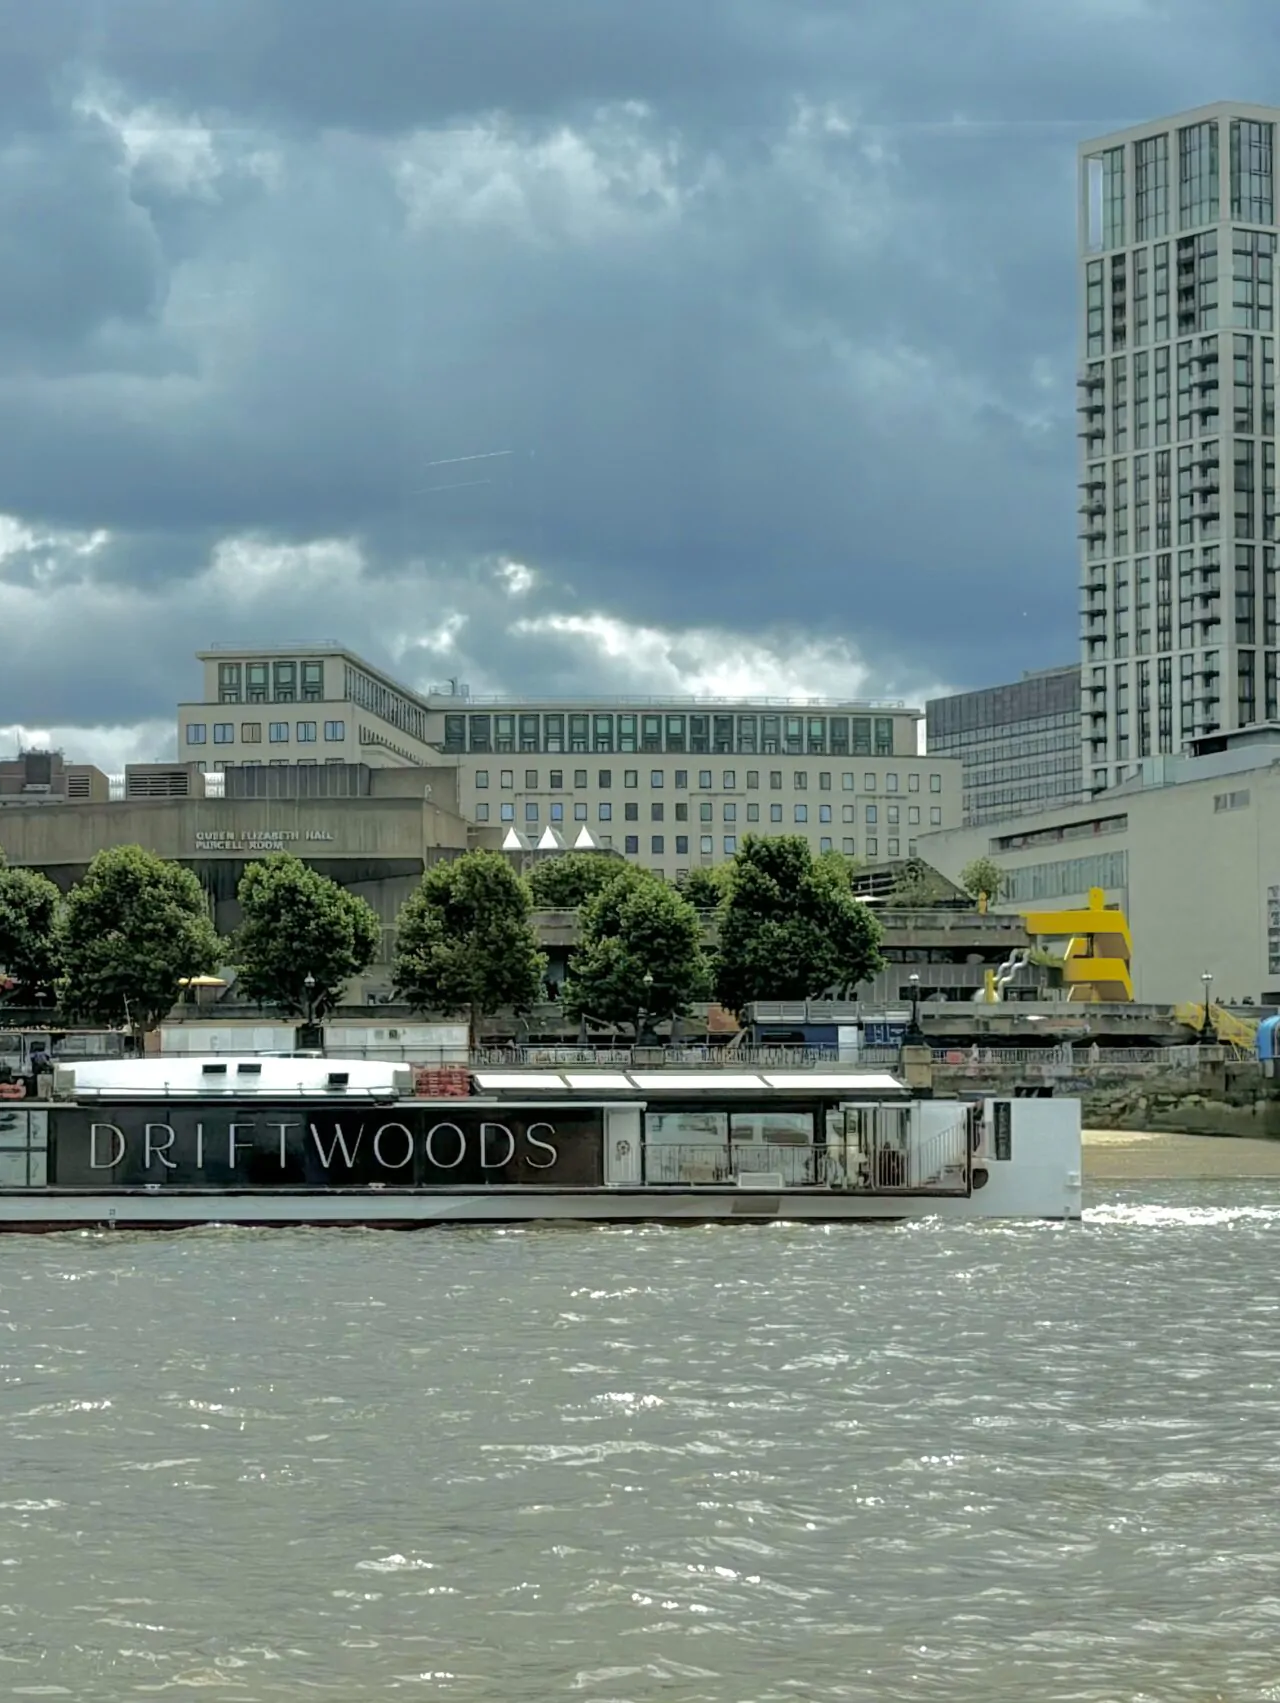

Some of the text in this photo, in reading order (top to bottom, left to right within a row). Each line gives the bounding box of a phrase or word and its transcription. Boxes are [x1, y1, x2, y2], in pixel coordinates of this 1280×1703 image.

[195, 830, 334, 841] QUEEN ELIZABETH HALL
[195, 841, 285, 850] PURCELL ROOM
[89, 1122, 558, 1169] DRIFTWOODS
